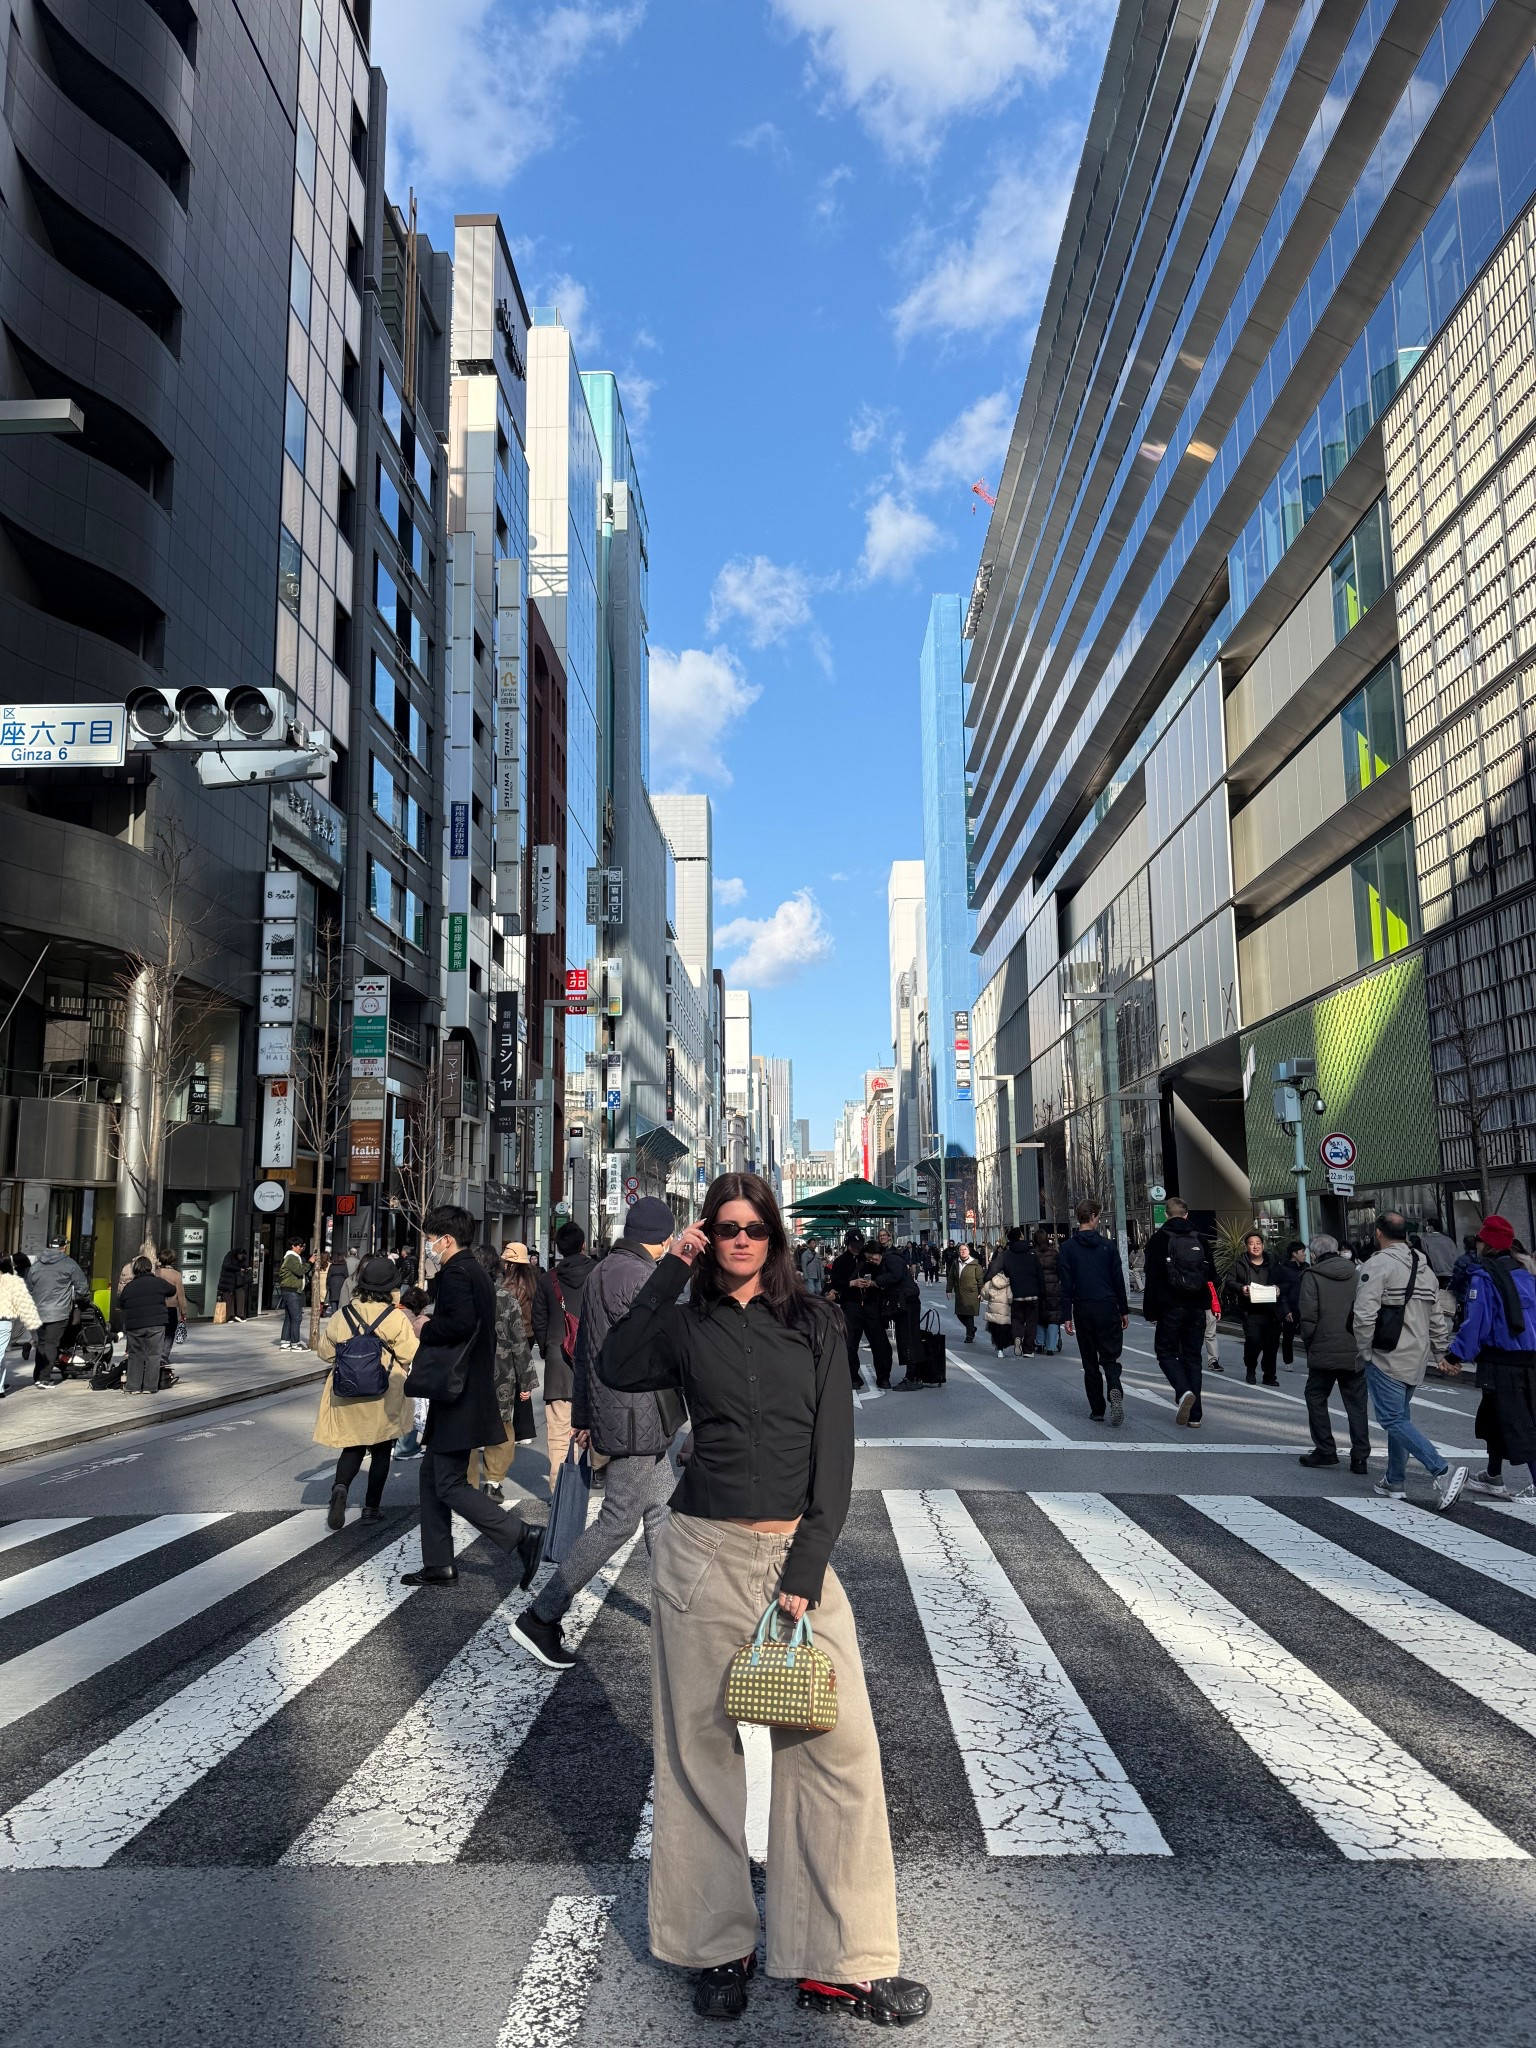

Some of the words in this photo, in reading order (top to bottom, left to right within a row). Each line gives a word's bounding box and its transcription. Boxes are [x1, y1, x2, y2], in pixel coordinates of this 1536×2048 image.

[4, 708, 16, 719] 区
[11, 748, 51, 761] Ginza
[58, 747, 68, 760] 6
[455, 805, 465, 855] 銀座総合法律事務所
[540, 867, 552, 912] DIANA
[453, 916, 462, 968] 西銀座診療所
[500, 1034, 513, 1092] ヨシノヤ
